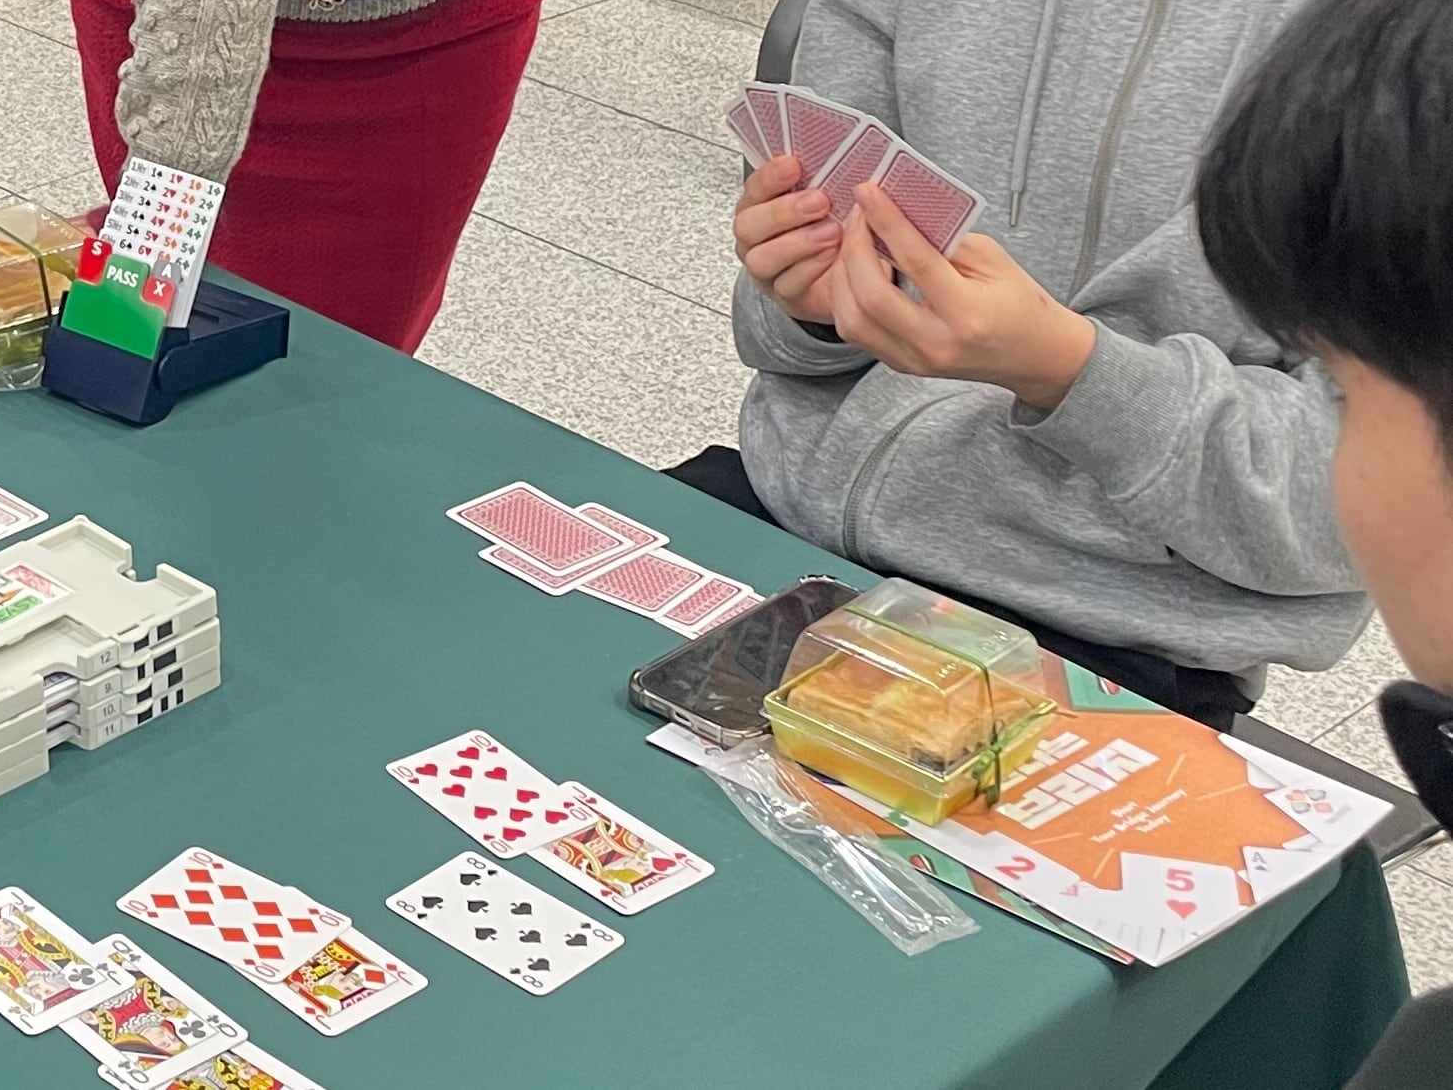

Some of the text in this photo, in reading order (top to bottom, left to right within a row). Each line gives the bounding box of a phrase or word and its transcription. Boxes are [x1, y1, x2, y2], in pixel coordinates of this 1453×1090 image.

[91, 241, 103, 256] S
[107, 265, 139, 288] PASS
[161, 264, 172, 278] A
[153, 281, 166, 297] X
[995, 737, 1161, 830] 브리지
[995, 856, 1036, 881] 2
[1165, 868, 1195, 893] 5
